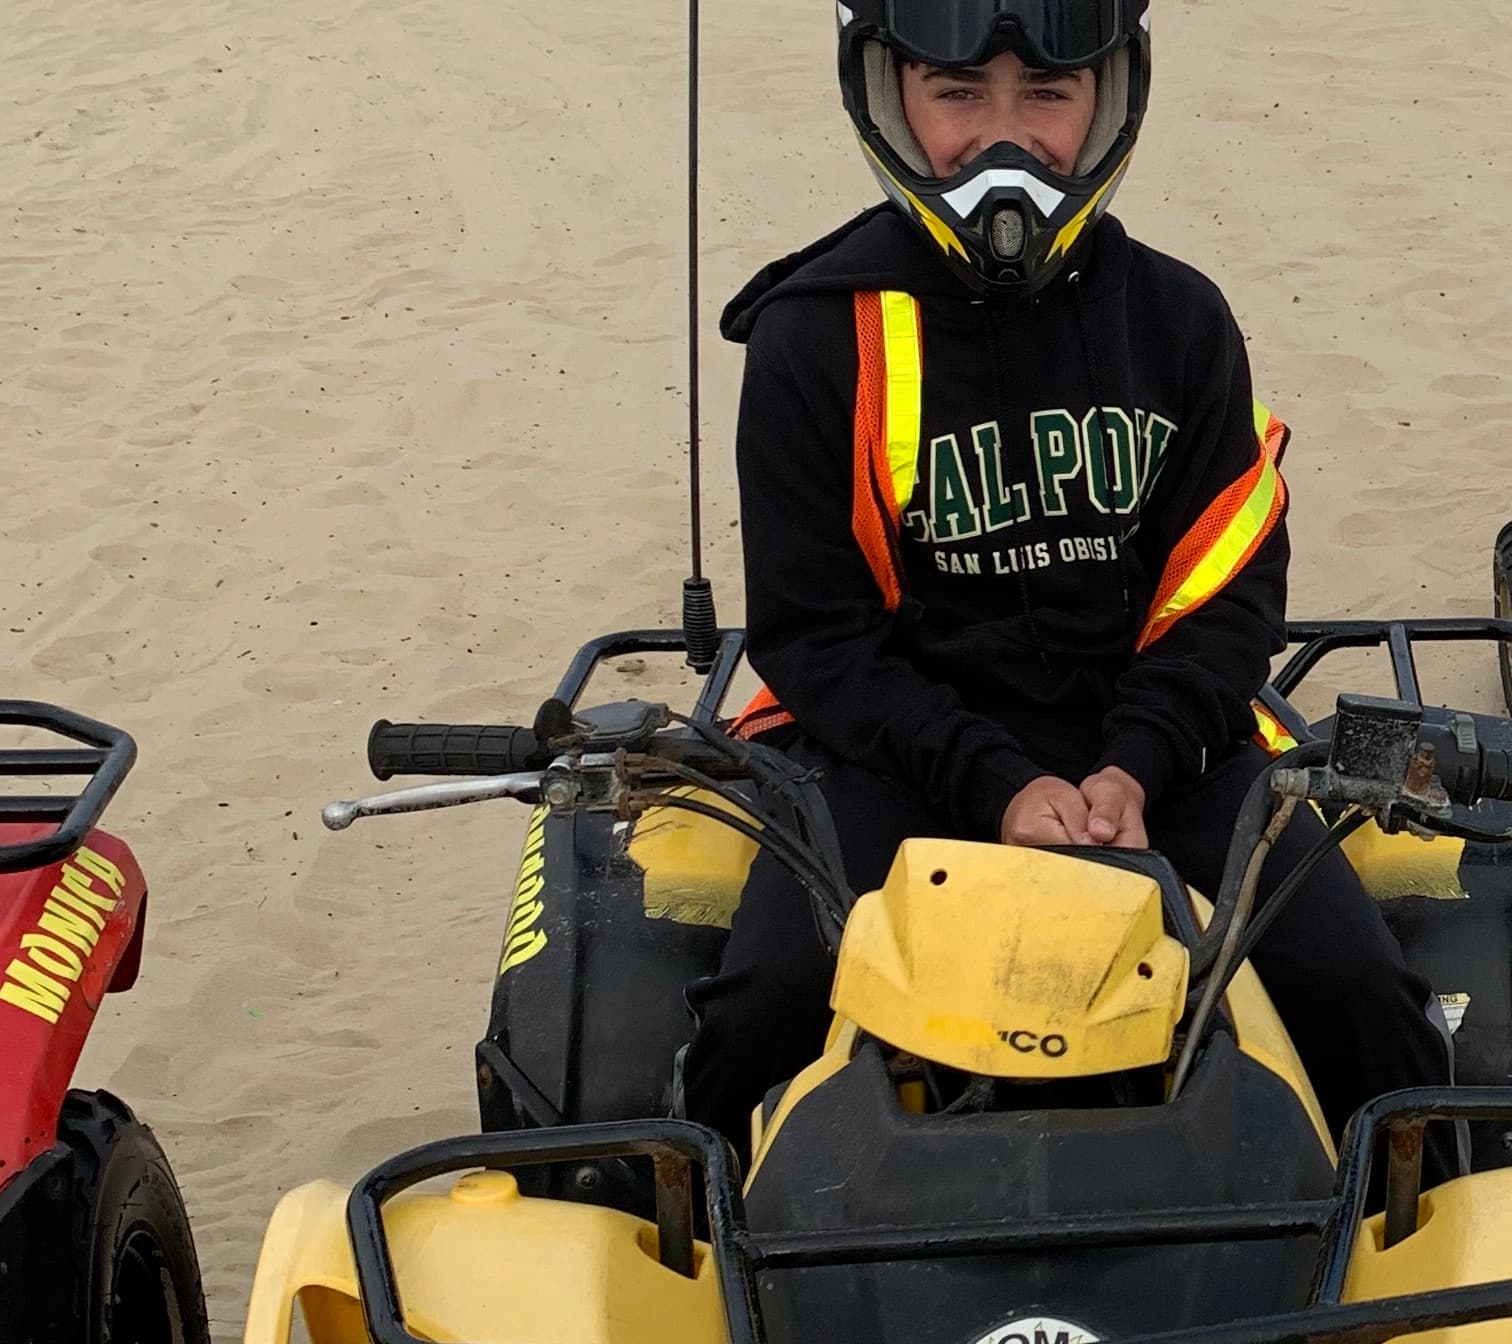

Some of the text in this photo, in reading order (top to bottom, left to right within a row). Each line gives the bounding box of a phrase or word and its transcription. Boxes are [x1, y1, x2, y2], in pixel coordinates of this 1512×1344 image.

[934, 550, 982, 575] SAN
[993, 542, 1051, 575] LUIS
[0, 845, 128, 1025] MONICA
